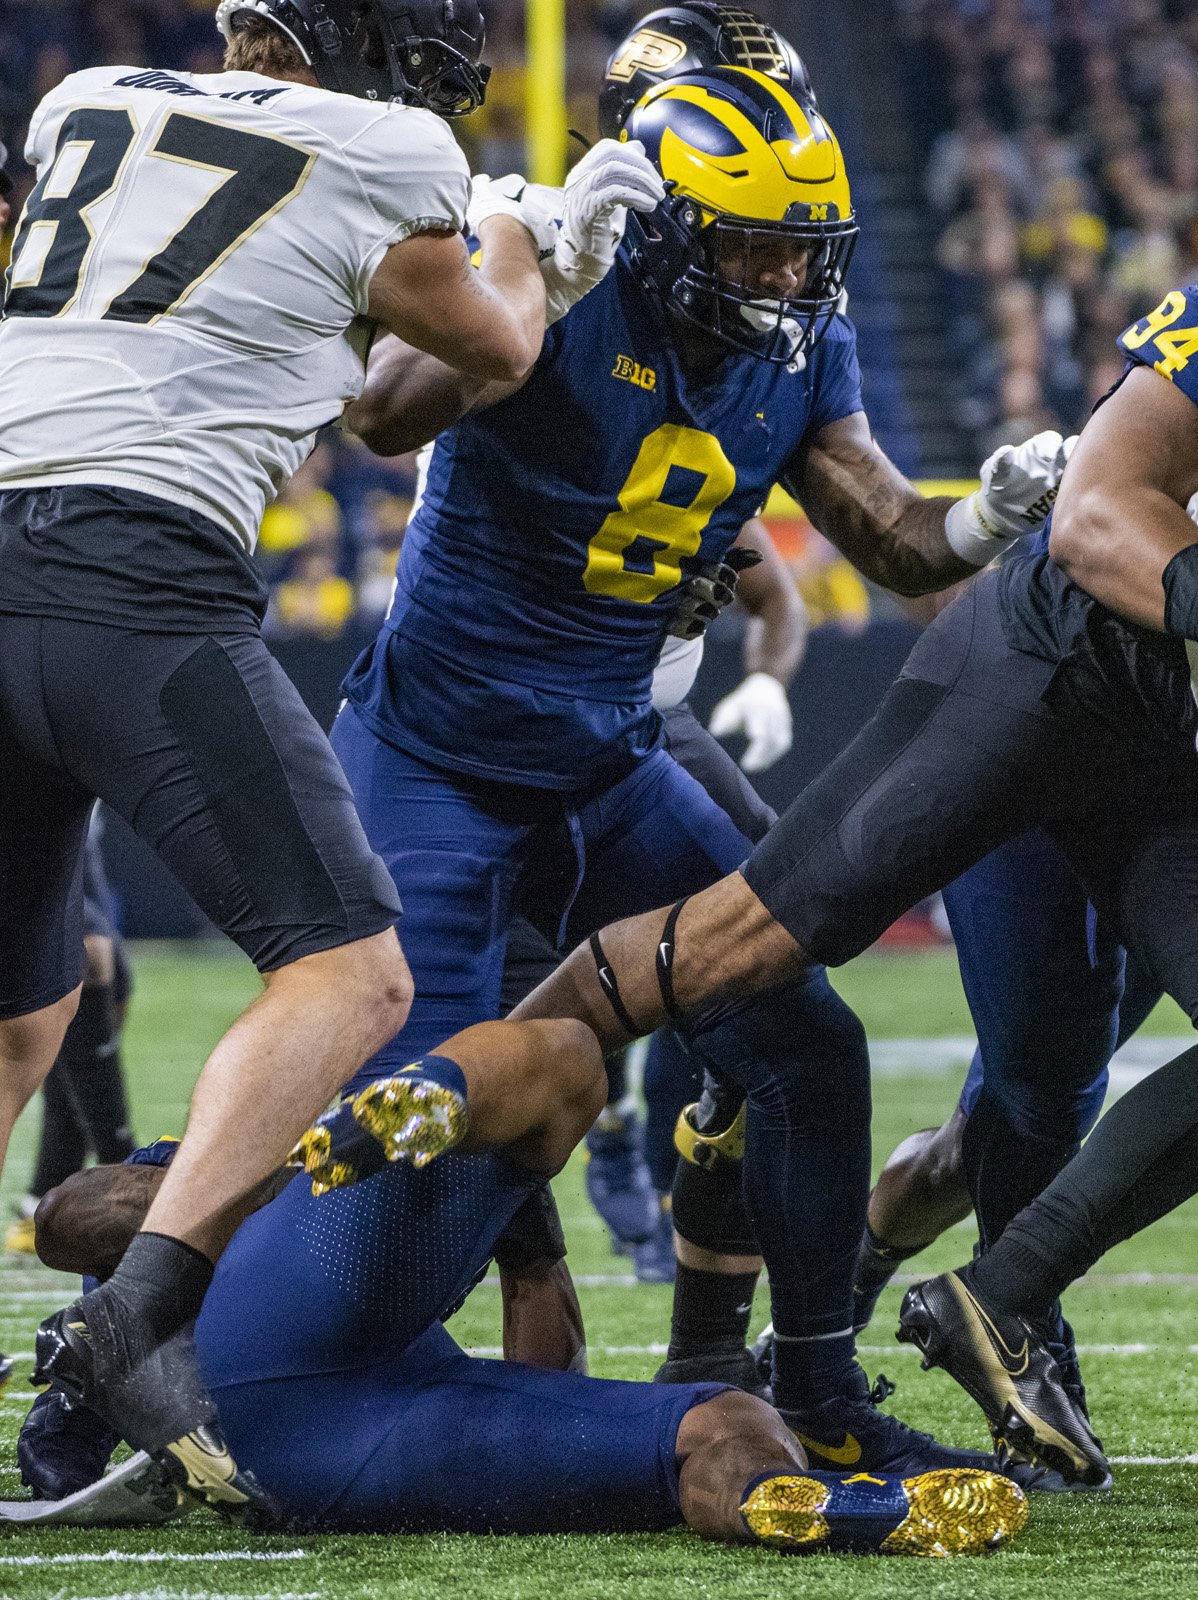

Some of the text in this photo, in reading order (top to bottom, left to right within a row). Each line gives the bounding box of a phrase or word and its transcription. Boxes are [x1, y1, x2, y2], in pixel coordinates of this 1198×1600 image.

[606, 28, 688, 83] P
[2, 104, 319, 328] 87
[809, 204, 828, 221] M
[582, 422, 737, 604] 8
